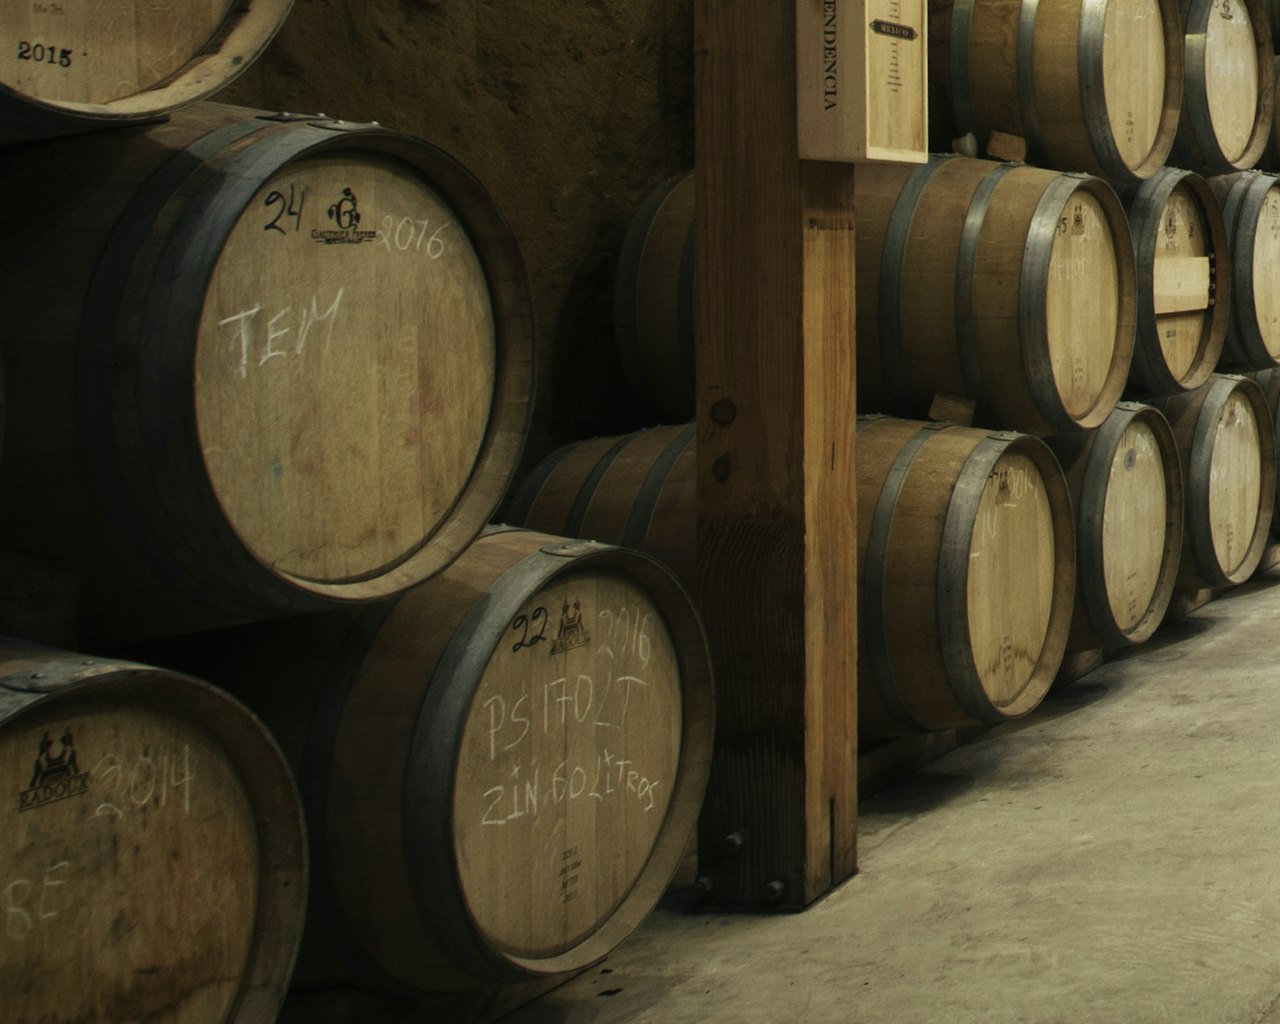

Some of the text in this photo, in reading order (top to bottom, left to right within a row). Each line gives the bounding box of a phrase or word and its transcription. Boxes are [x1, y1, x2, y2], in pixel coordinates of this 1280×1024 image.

[880, 22, 909, 37] MEXICO
[17, 39, 73, 69] 2015
[264, 183, 305, 236] 24
[374, 214, 452, 259] 2016
[218, 287, 344, 380] TEM
[512, 606, 549, 654] 22
[596, 607, 652, 664] 2016
[19, 771, 90, 814] RADOUX
